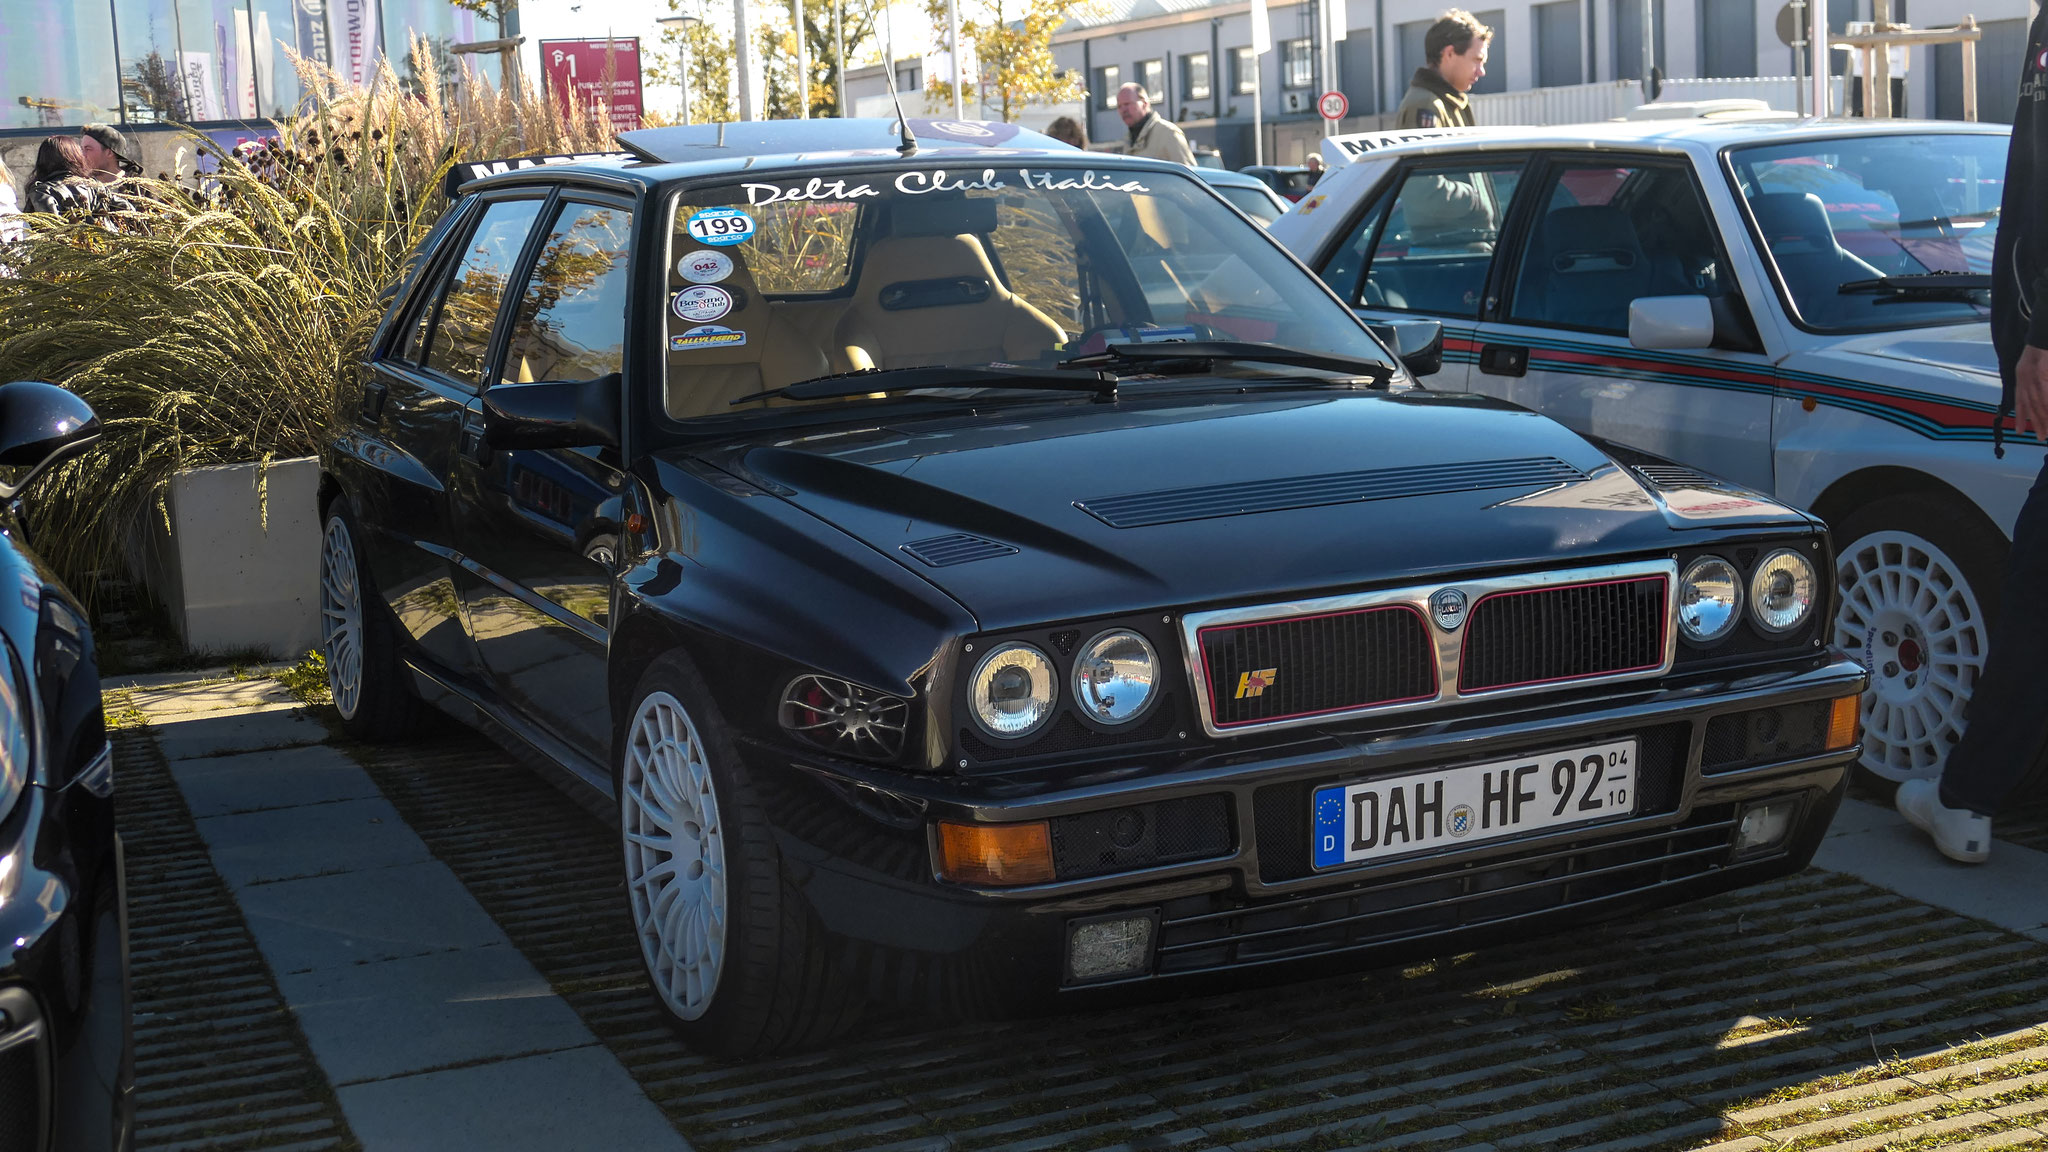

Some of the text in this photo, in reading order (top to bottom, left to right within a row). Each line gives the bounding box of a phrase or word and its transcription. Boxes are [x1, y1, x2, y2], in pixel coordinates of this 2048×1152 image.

[566, 54, 576, 78] 1
[605, 80, 635, 89] RKING
[1325, 100, 1341, 112] 30
[741, 168, 1150, 207] Delta Club Italia
[694, 217, 748, 236] 199
[707, 234, 743, 243] sparco
[694, 262, 718, 271] 042
[680, 296, 724, 308] Bassano
[1234, 667, 1278, 699] HF
[1609, 750, 1627, 767] 04
[1323, 834, 1335, 852] D
[1351, 780, 1444, 852] DAH
[1481, 764, 1539, 829] HF
[1551, 754, 1605, 817] 92
[1609, 789, 1626, 806] 10
